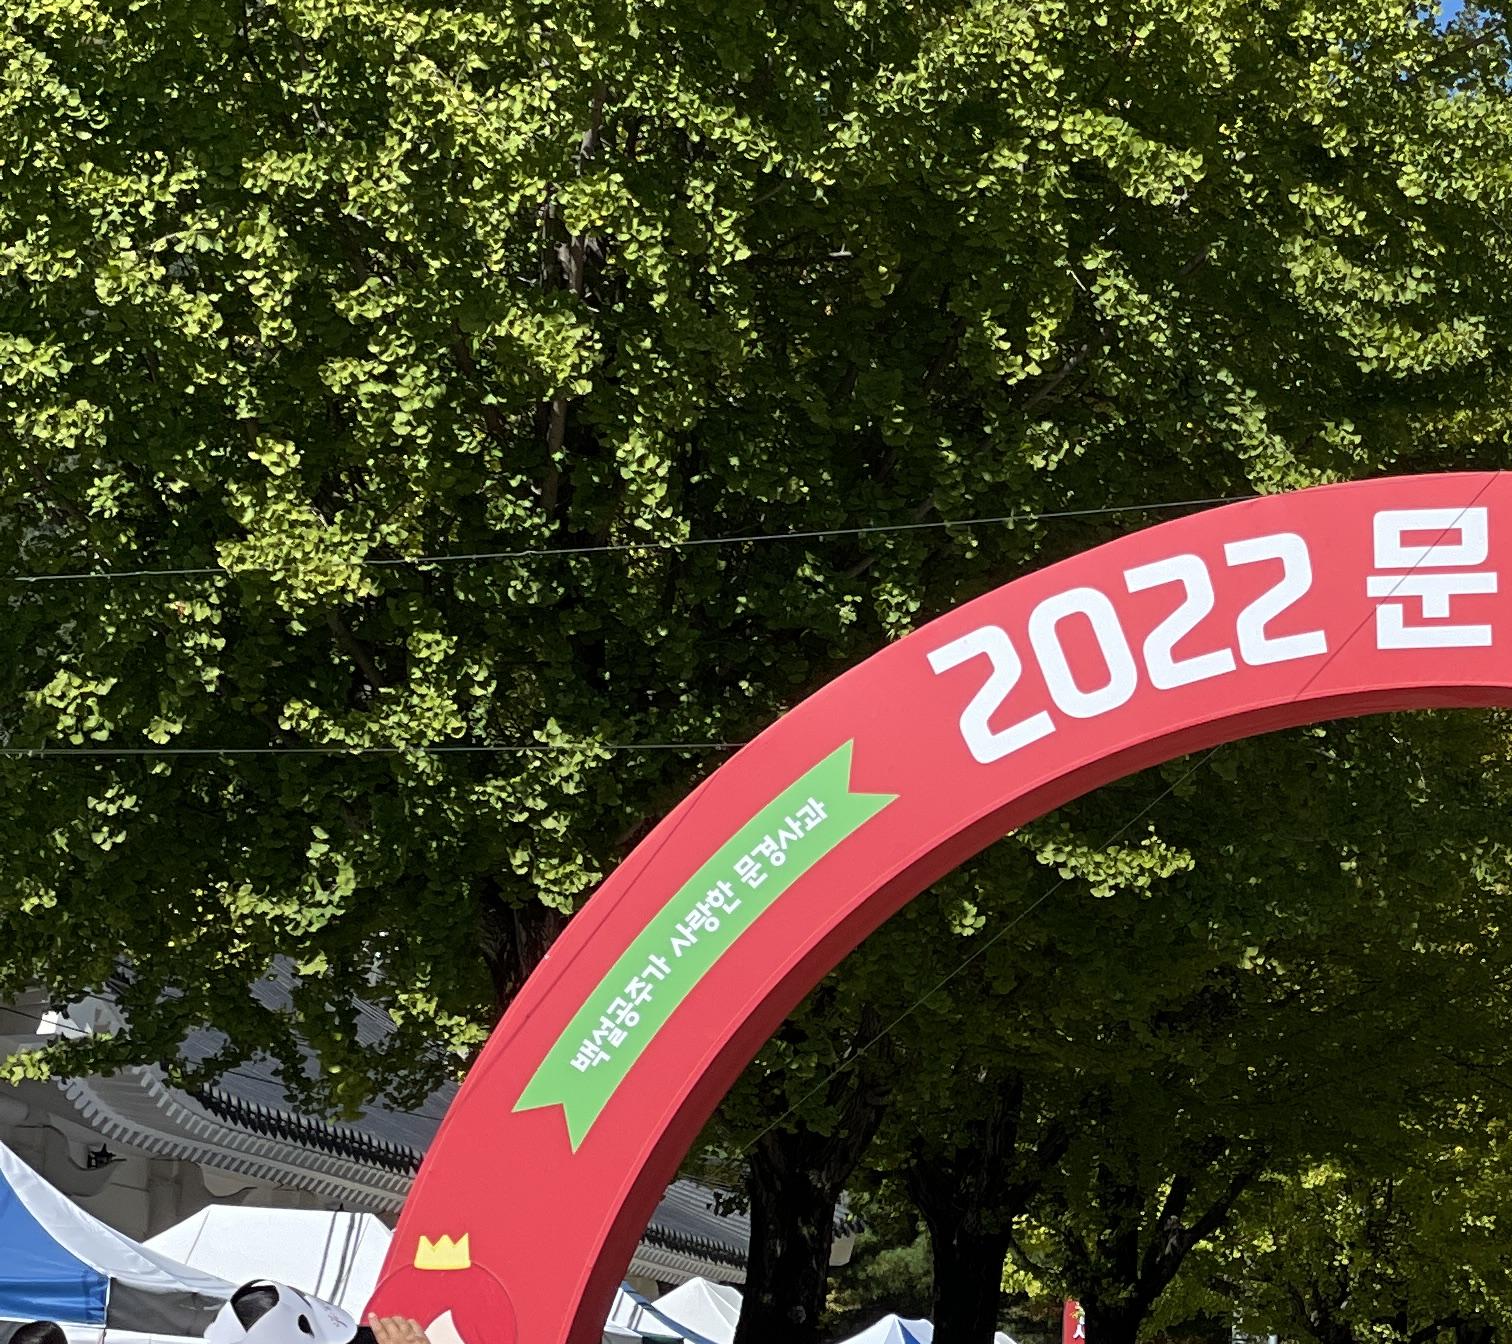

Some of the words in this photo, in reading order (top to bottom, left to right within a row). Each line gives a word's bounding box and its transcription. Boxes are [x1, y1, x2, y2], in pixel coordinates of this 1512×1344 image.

[926, 532, 1328, 764] 2022
[570, 954, 672, 1072] 백설공주가
[669, 879, 742, 957] 사랑한
[733, 797, 828, 890] 문경사과
